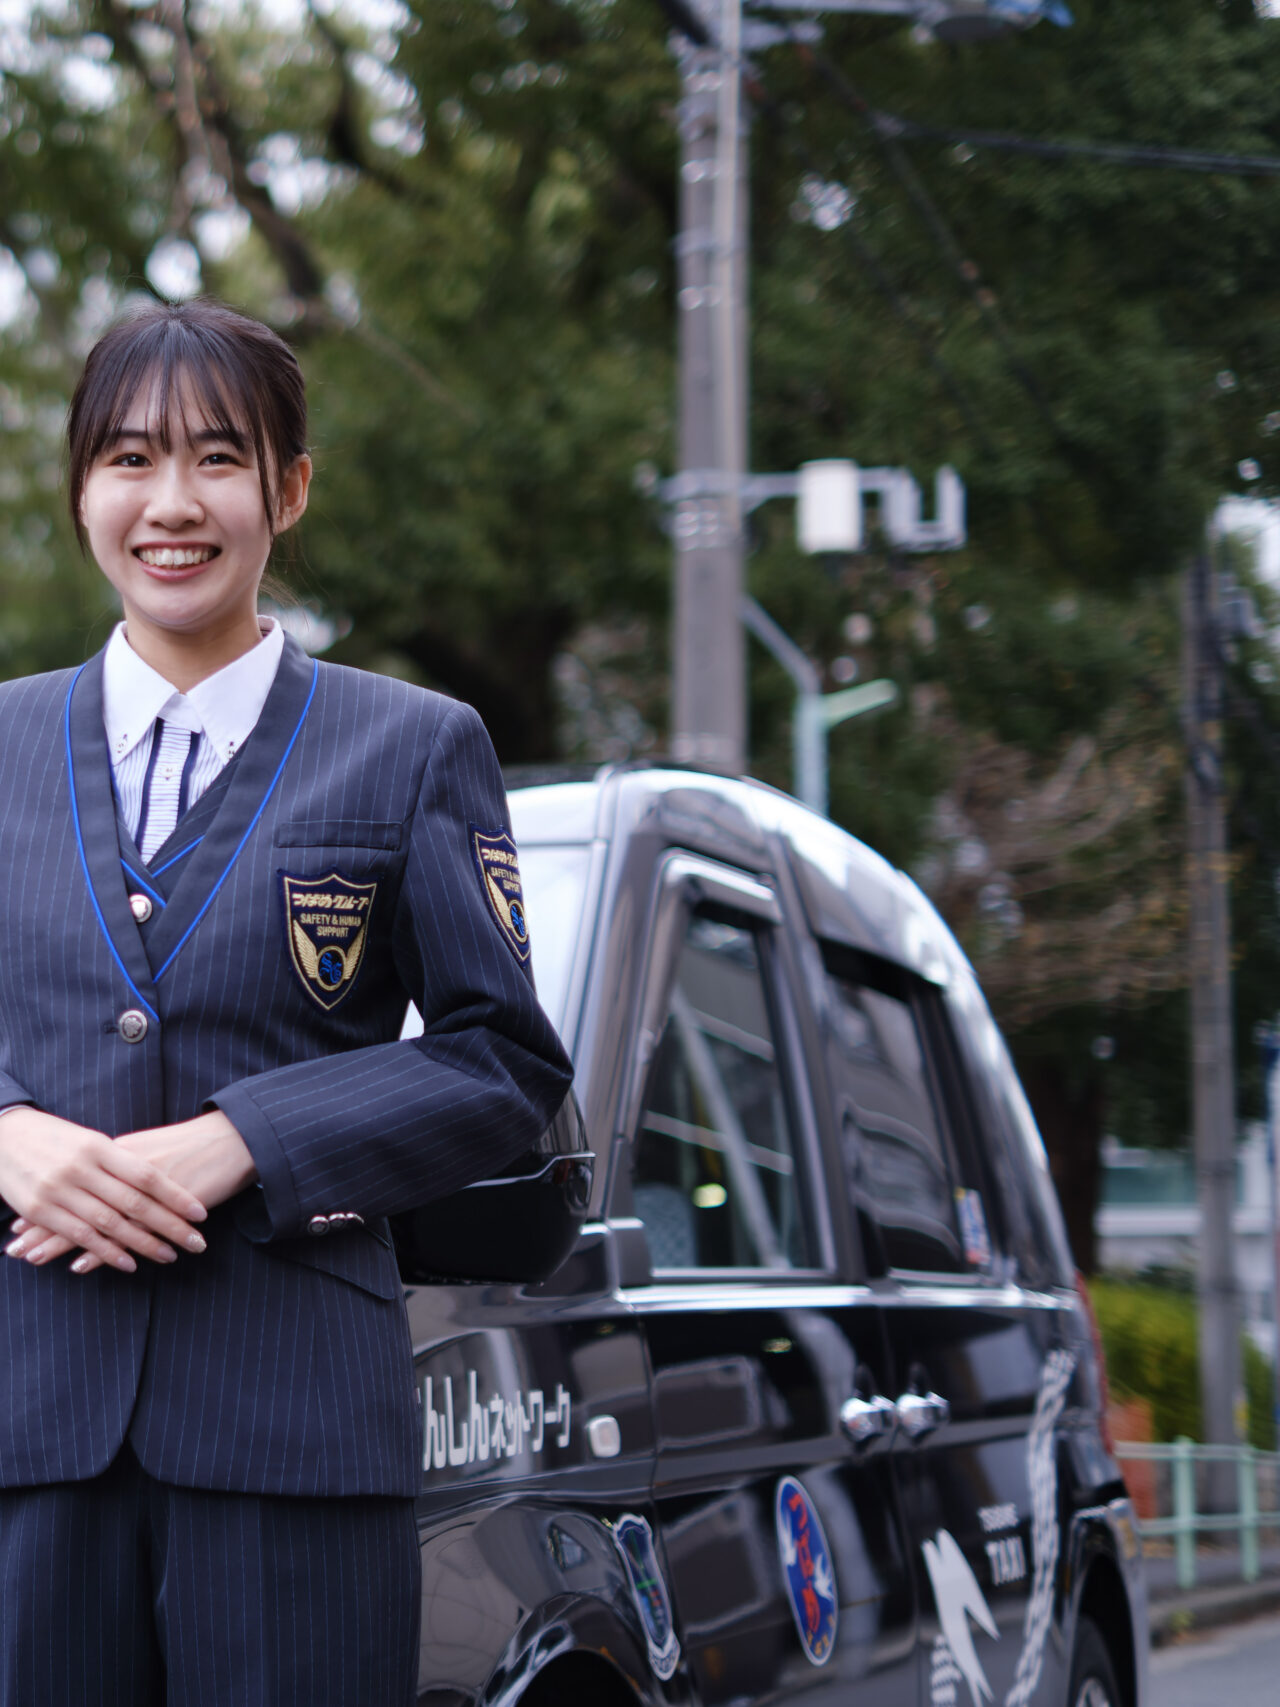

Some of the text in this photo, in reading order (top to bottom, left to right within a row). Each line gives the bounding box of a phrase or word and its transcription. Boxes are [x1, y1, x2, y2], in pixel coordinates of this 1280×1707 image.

[292, 892, 370, 911] つばめグループ
[300, 913, 362, 927] SAFETY & HUMAN
[316, 926, 350, 938] SUPPORT
[417, 1370, 571, 1471] んしんネットワーク
[984, 1537, 1027, 1586] TAXI
